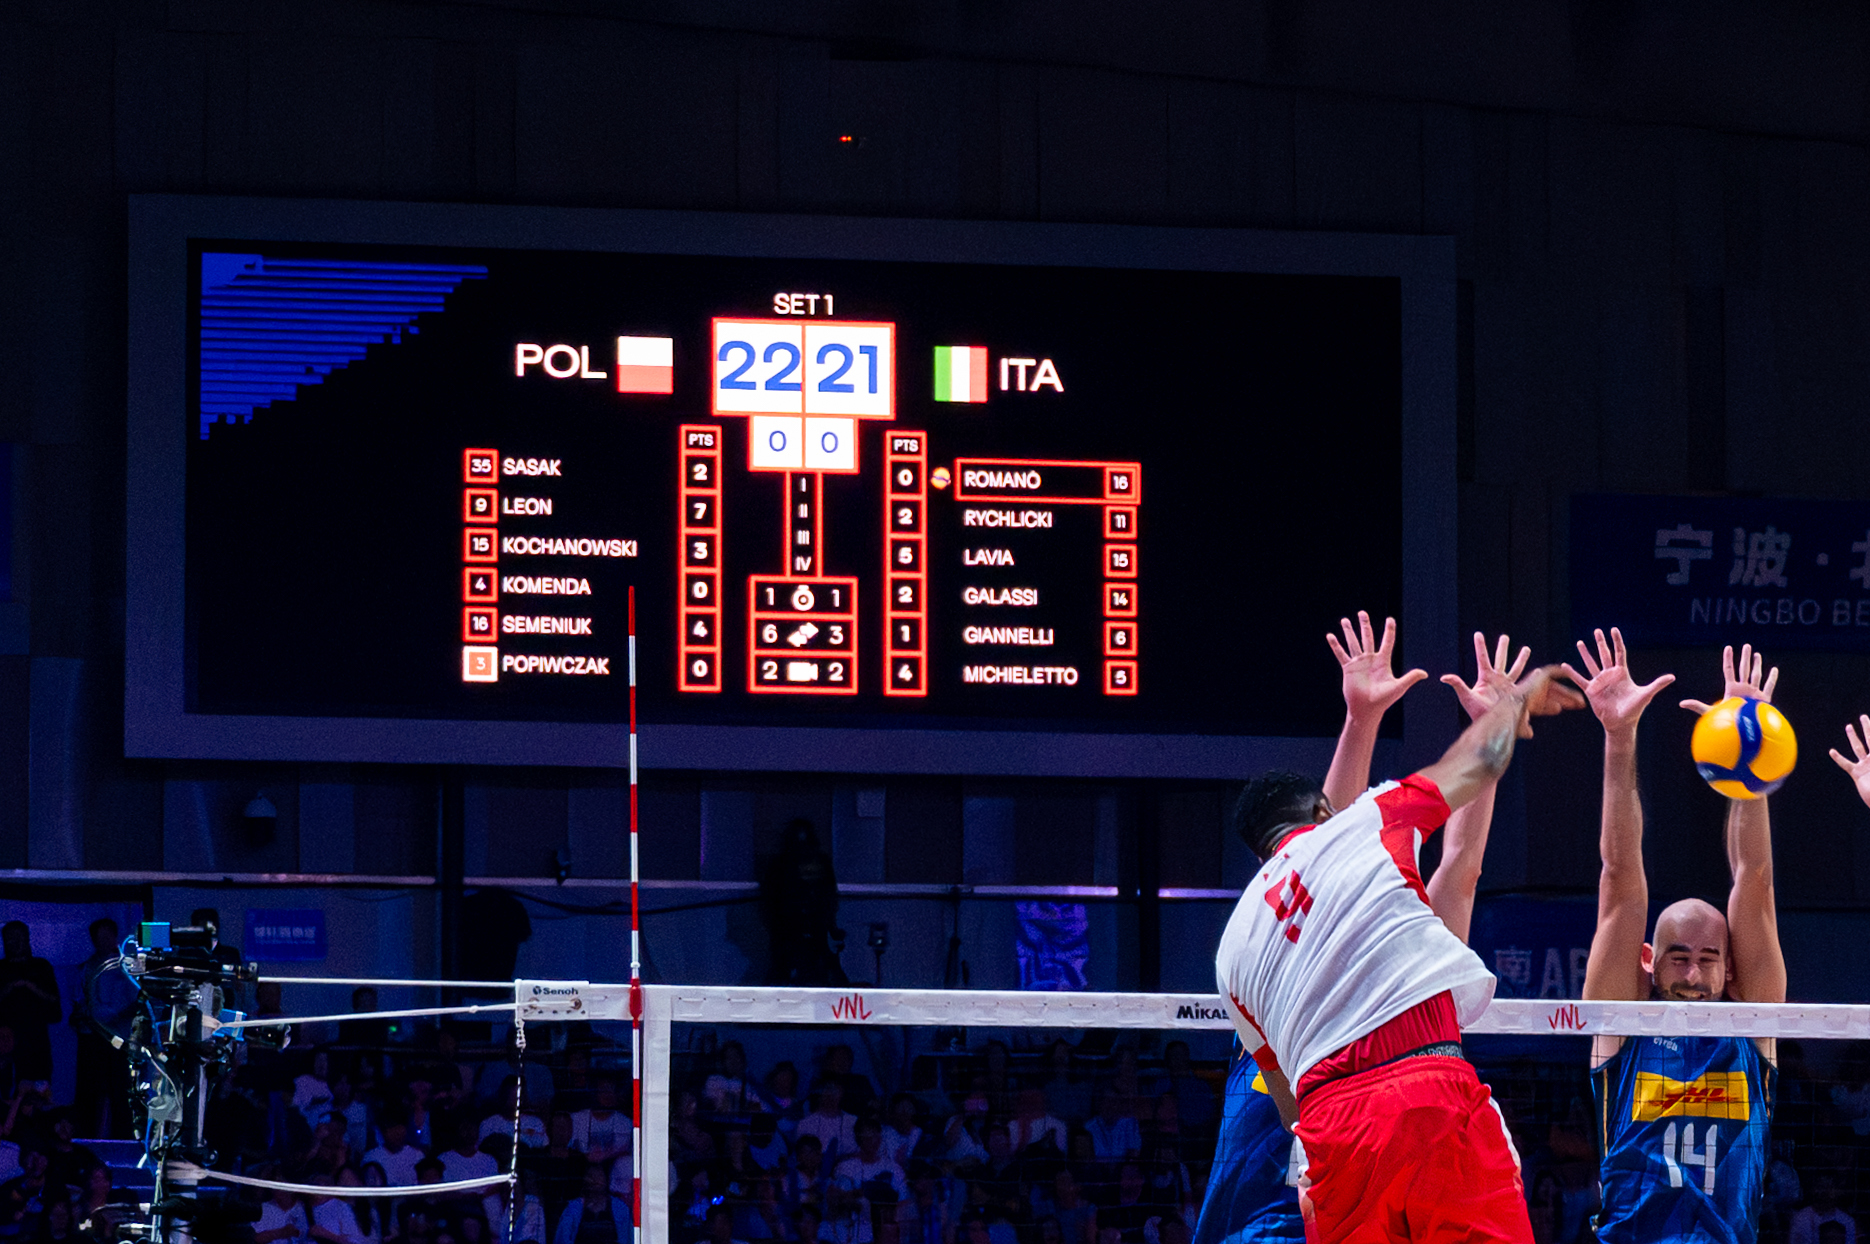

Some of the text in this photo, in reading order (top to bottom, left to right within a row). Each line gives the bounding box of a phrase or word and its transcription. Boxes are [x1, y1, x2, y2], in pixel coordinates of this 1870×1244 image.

[774, 293, 833, 315] SET 1
[517, 344, 607, 378] POL
[718, 340, 802, 391] 22
[816, 343, 878, 394] 21
[1001, 358, 1064, 392] ITA
[689, 434, 713, 446] PTS
[769, 430, 787, 452] 0
[821, 431, 838, 453] 0
[894, 439, 918, 452] PTS
[472, 458, 561, 475] 35 SASAK
[694, 464, 707, 480] 2
[898, 469, 912, 485] 0
[1114, 476, 1128, 489] 16
[475, 498, 552, 515] 9 LEON
[694, 503, 706, 519] 7
[899, 508, 912, 524] 2
[964, 510, 1125, 528] RYCHLICKI 11
[473, 537, 637, 556] 15 KOCHANOWSKI
[694, 542, 707, 559] 3
[899, 547, 912, 563] 5
[965, 549, 1128, 567] LAVIA 15
[476, 576, 591, 594] 4 KOMENDA
[693, 582, 707, 598] 0
[899, 586, 912, 602] 2
[767, 588, 839, 607] 1 1
[964, 587, 1128, 605] GALASSI 14
[1690, 598, 1820, 625] NINGBO
[473, 615, 591, 634] 16 SEMENIUK
[694, 621, 707, 637] 4
[901, 625, 909, 641] 1
[763, 624, 843, 644] 6 3
[964, 626, 1126, 645] GIANNELLI 6
[476, 655, 608, 674] 3 POPIWCZAK
[693, 660, 707, 677] 0
[763, 661, 843, 681] 2 2
[899, 665, 912, 681] 4
[964, 666, 1126, 684] MICHIELETTO 5
[544, 987, 578, 996] Senoh
[832, 993, 872, 1019] VNL
[1548, 1003, 1587, 1030] VNL
[1663, 1121, 1718, 1195] 14
